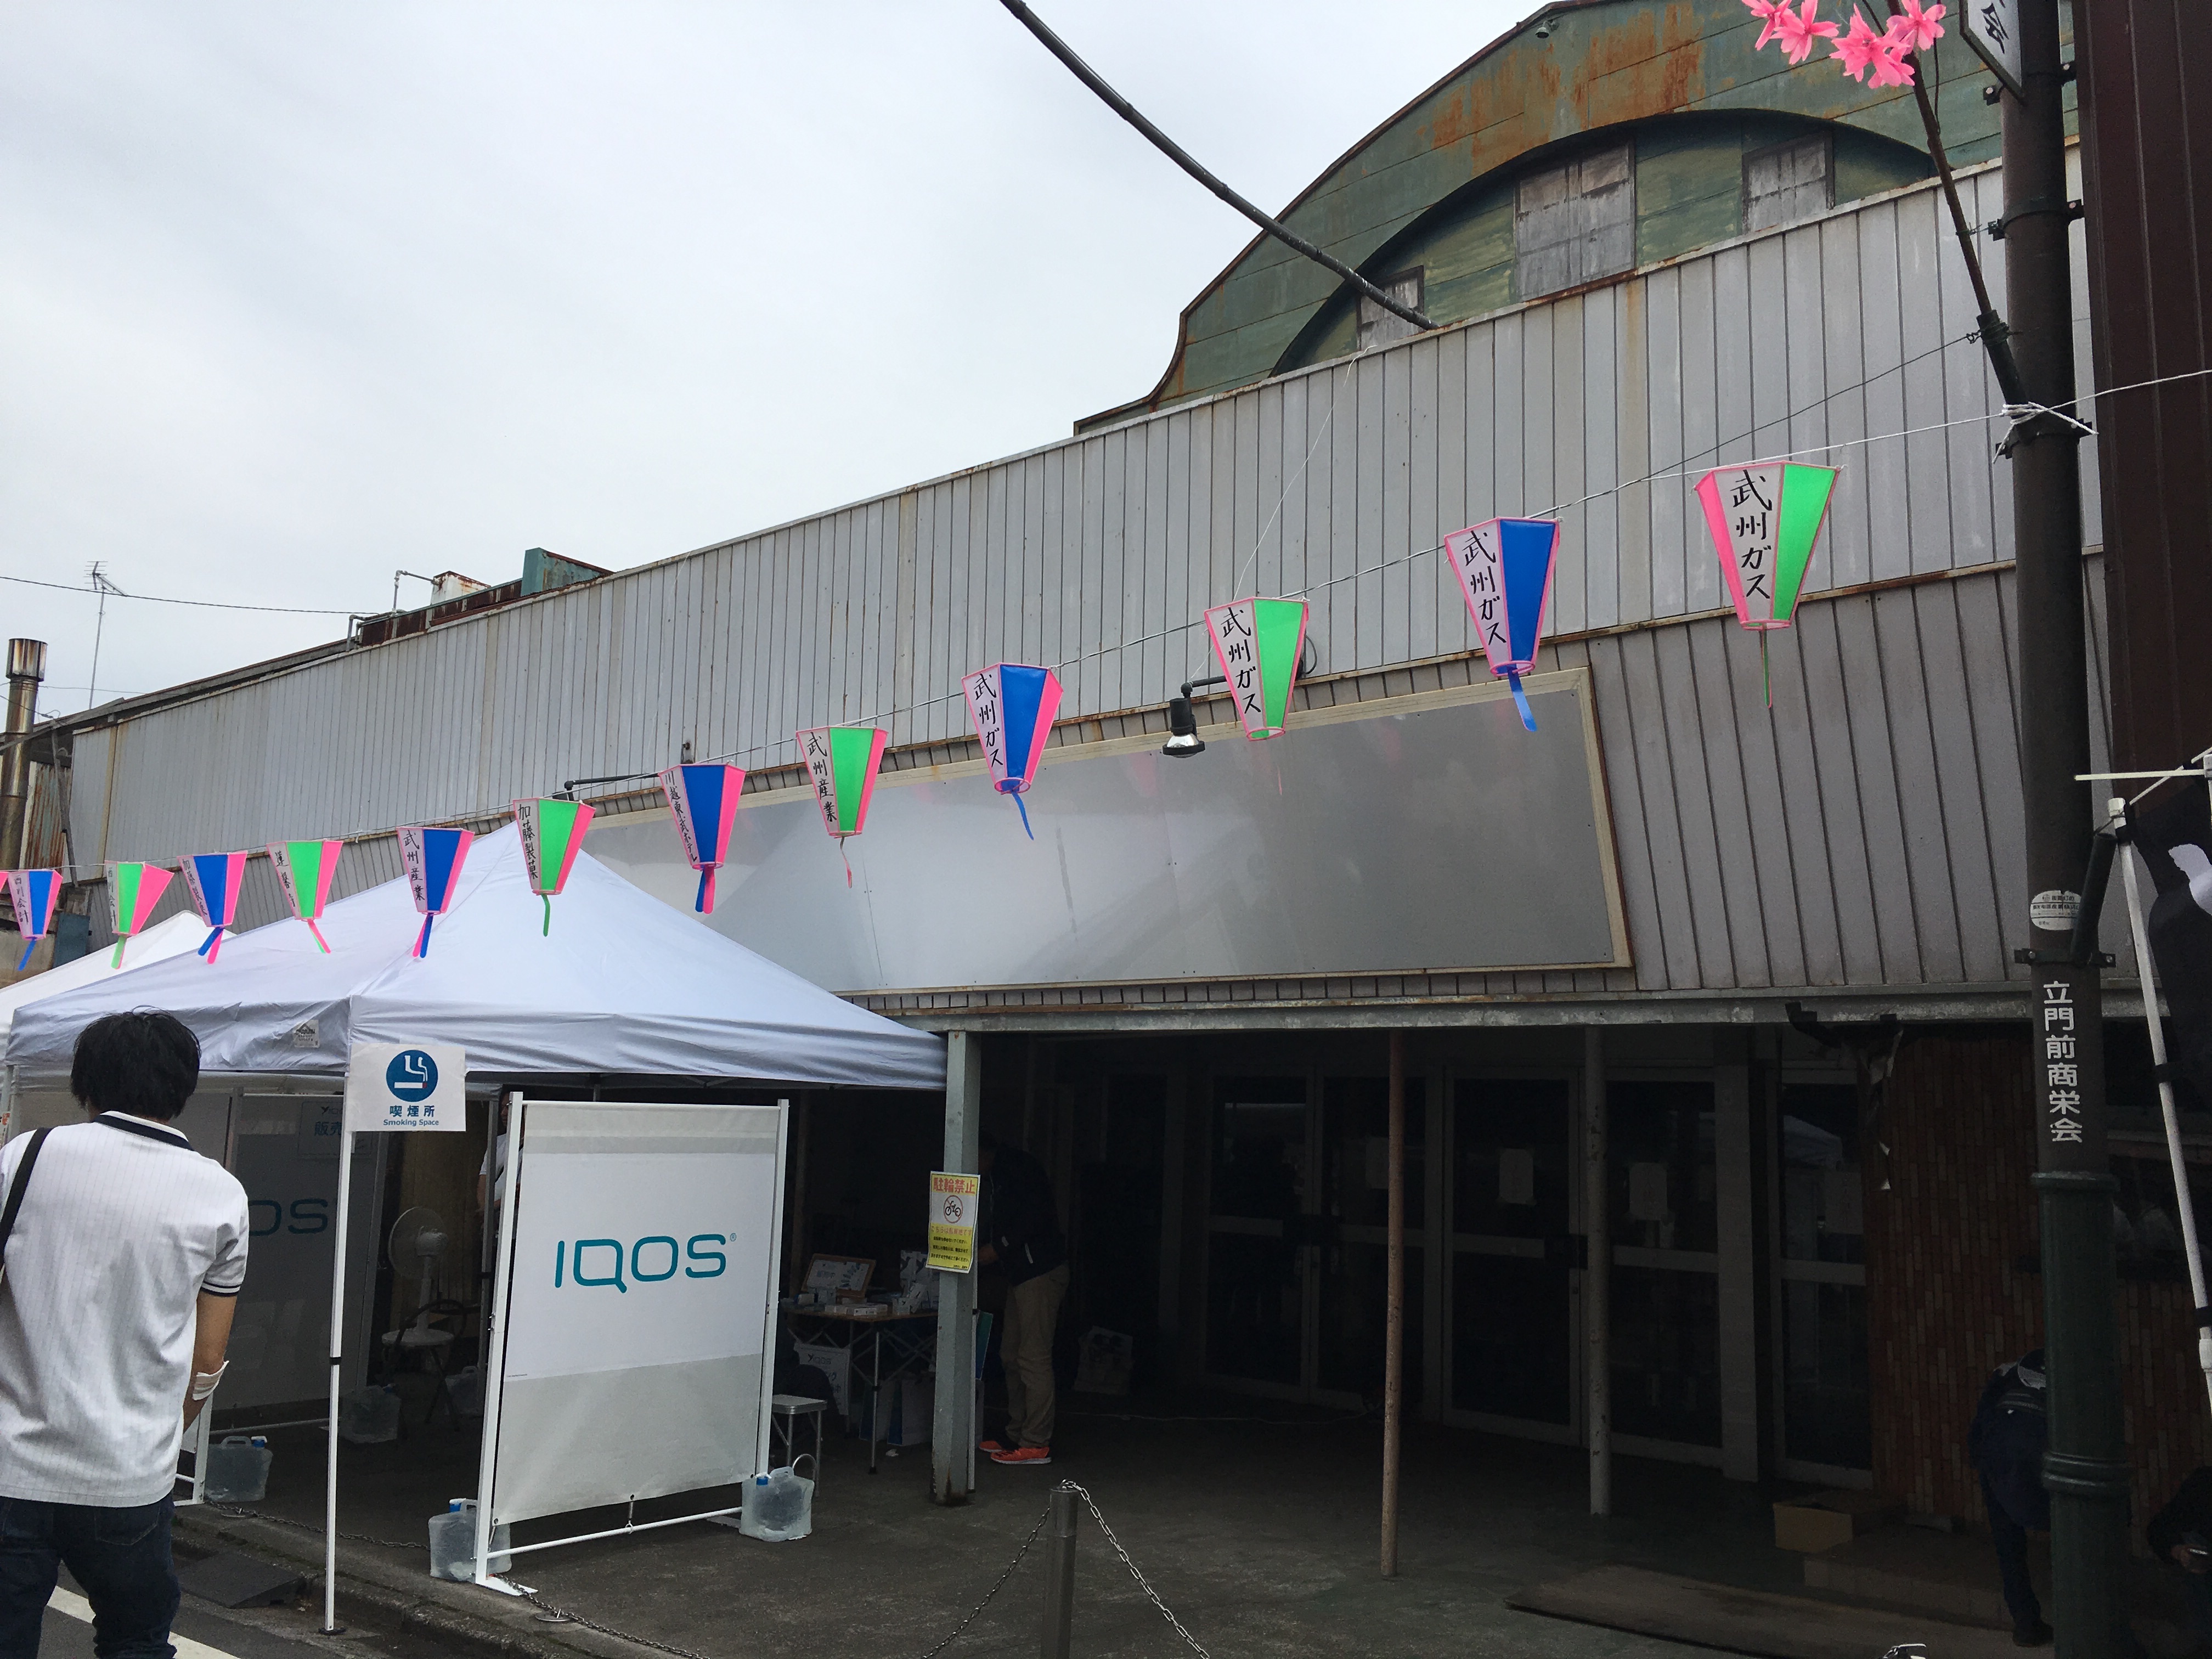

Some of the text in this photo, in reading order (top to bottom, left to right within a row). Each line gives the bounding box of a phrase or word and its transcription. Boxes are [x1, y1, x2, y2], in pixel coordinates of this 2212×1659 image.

[1981, 0, 2009, 54] 会
[1730, 469, 1772, 599] 武州ガス
[1463, 531, 1507, 646] 武州ガス
[1221, 607, 1261, 714] 武州ガス
[974, 673, 1003, 769] 武州ガス
[665, 770, 698, 862] 川越東武ホテル
[807, 732, 837, 822] 武州産業
[403, 832, 426, 902] 武州産業
[518, 804, 539, 880] 加藤製菓
[2042, 980, 2083, 1143] 立門前商栄会
[390, 1105, 435, 1118] 喫煙所
[934, 1177, 975, 1194] 駐輪禁止
